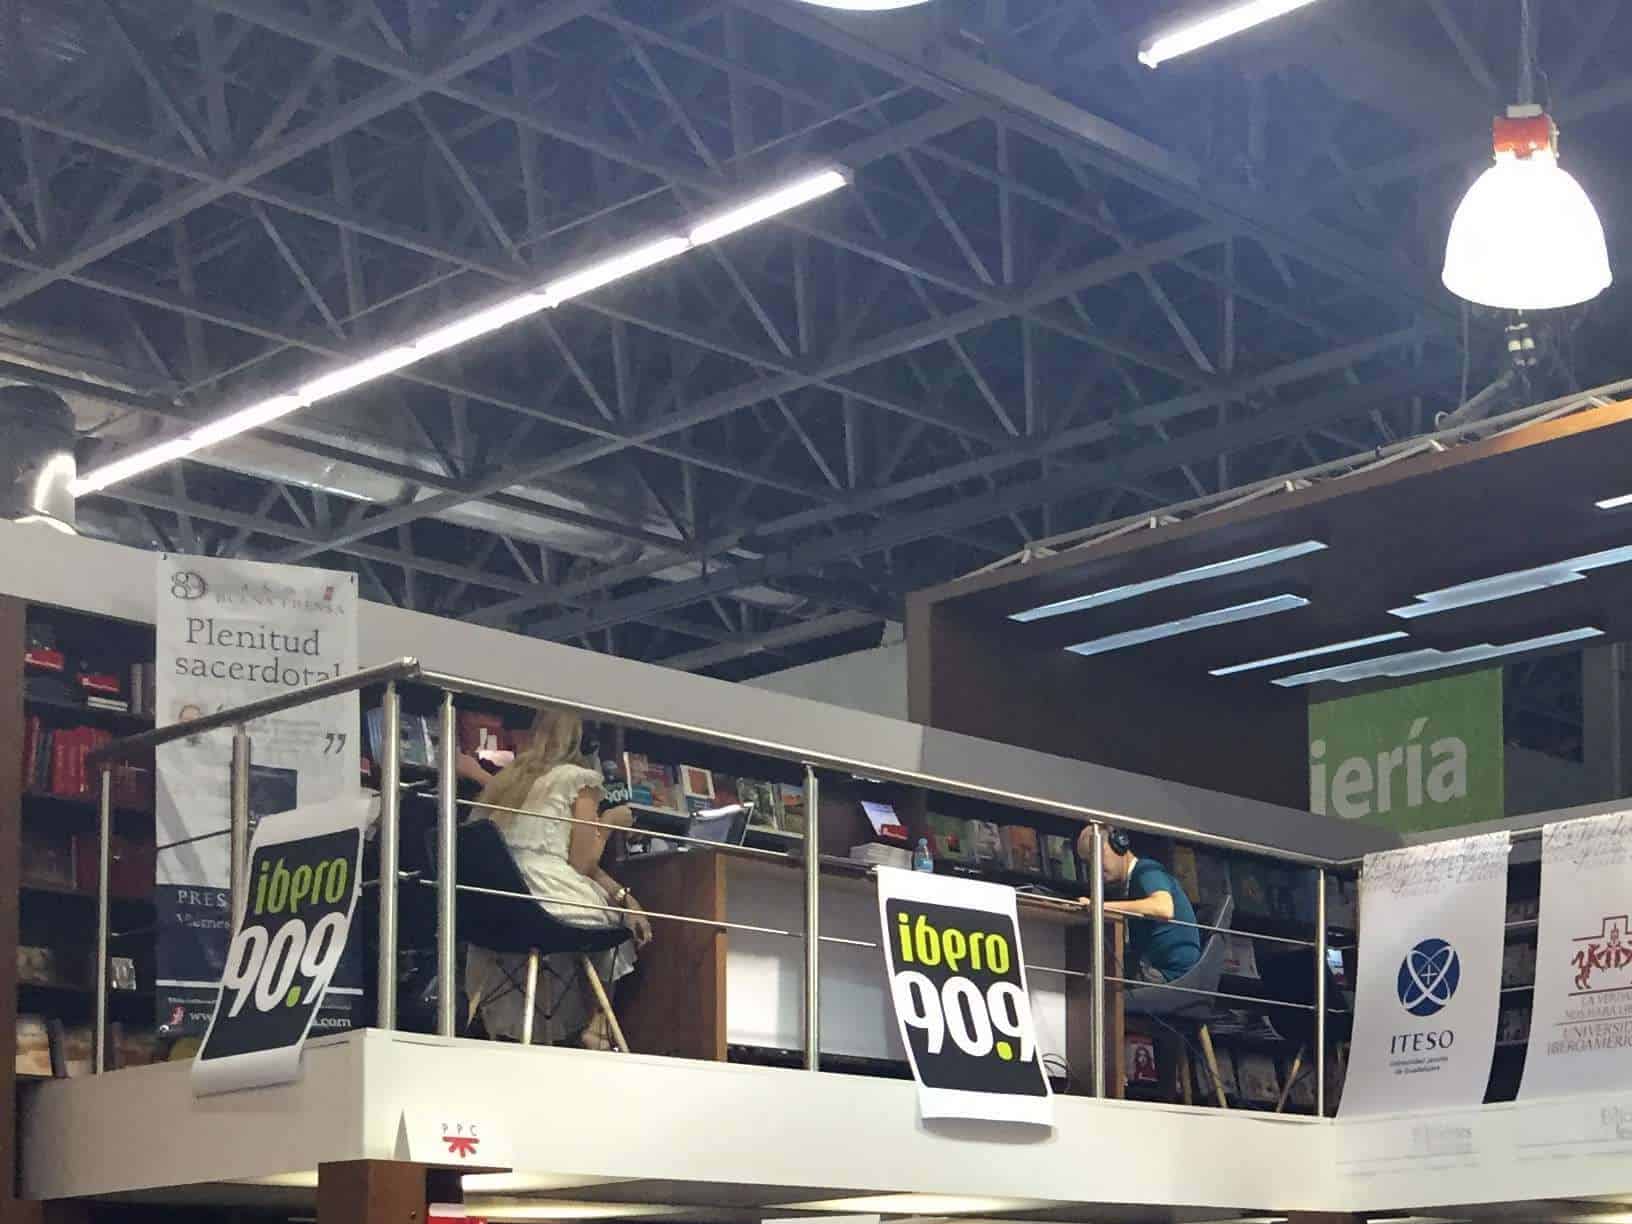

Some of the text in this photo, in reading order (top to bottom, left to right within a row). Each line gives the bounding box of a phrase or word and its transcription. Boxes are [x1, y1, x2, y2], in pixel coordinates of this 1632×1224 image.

[186, 617, 320, 656] Plenitud
[254, 857, 348, 915] ibero
[898, 911, 1010, 974] ibero
[894, 969, 1035, 1062] 90.9
[1390, 1030, 1455, 1055] ITESO
